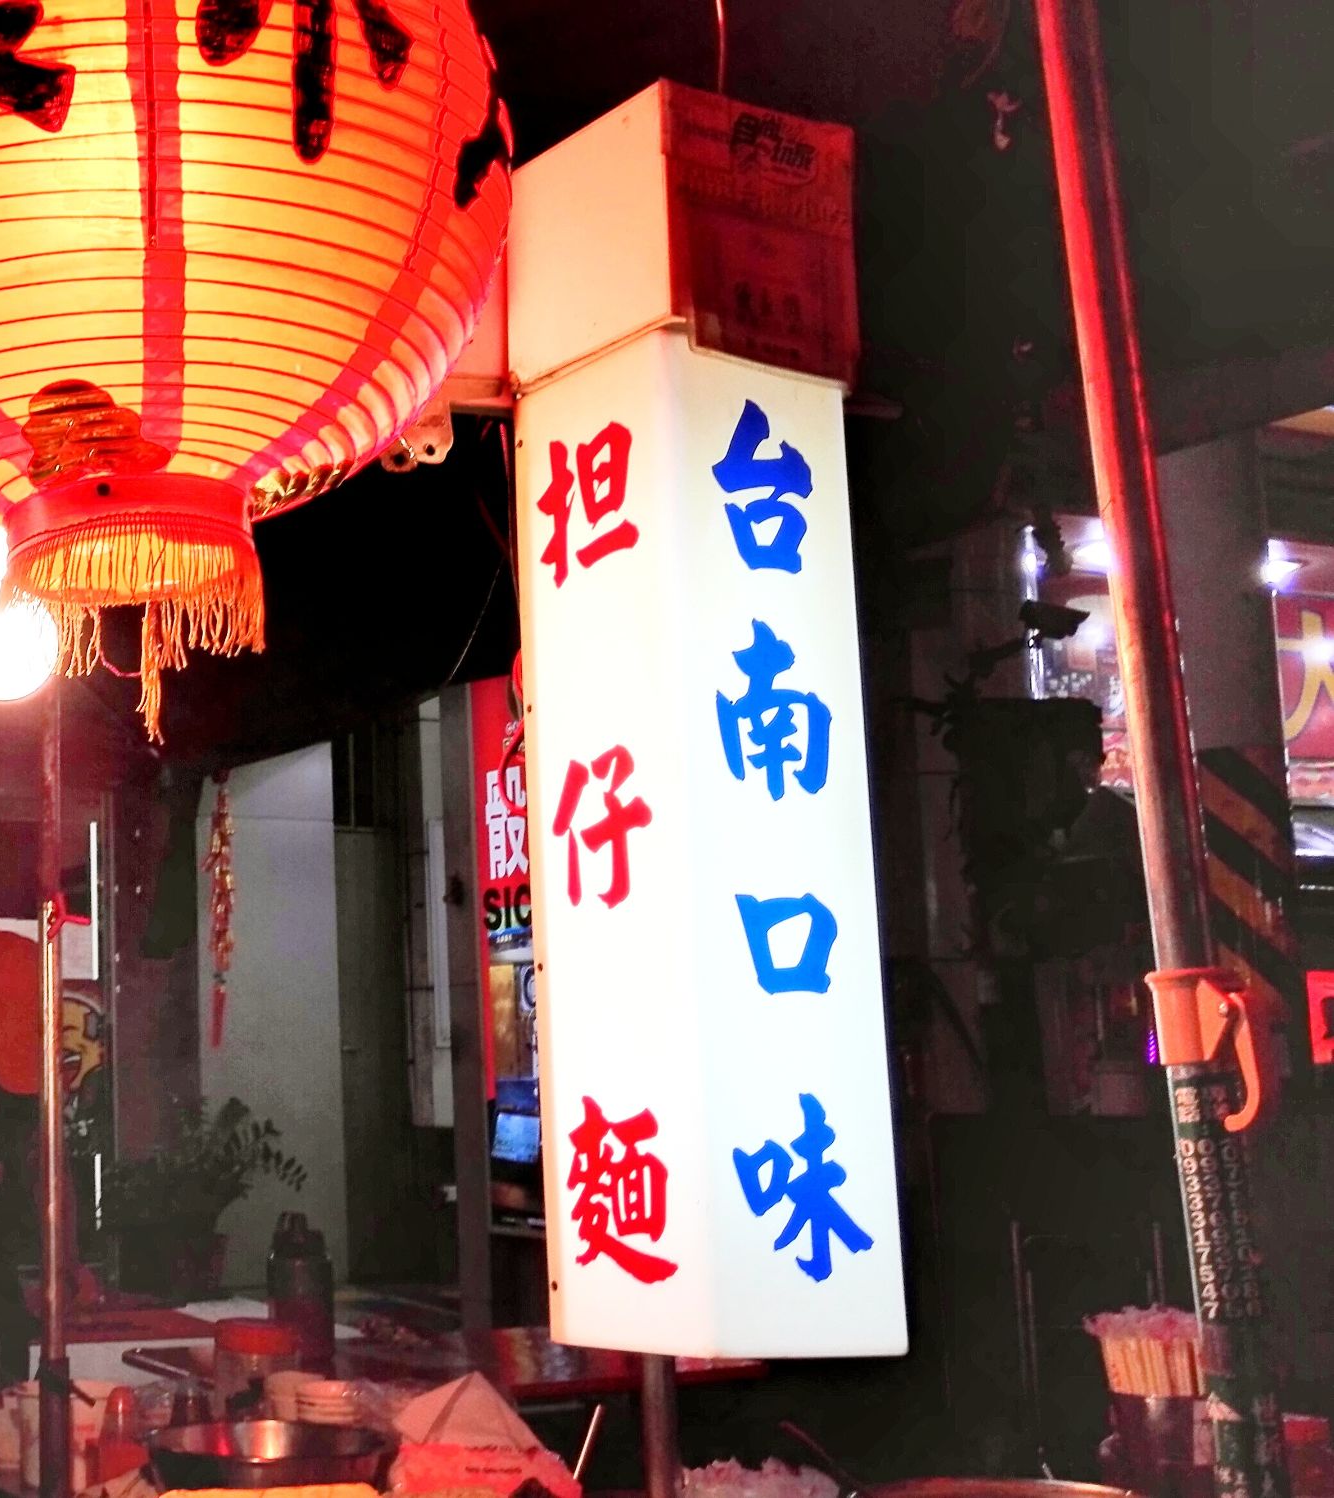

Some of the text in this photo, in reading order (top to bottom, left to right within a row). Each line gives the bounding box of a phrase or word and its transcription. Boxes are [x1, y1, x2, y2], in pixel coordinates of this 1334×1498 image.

[537, 421, 679, 1285] 担仔麵
[712, 398, 874, 1284] 台南口味
